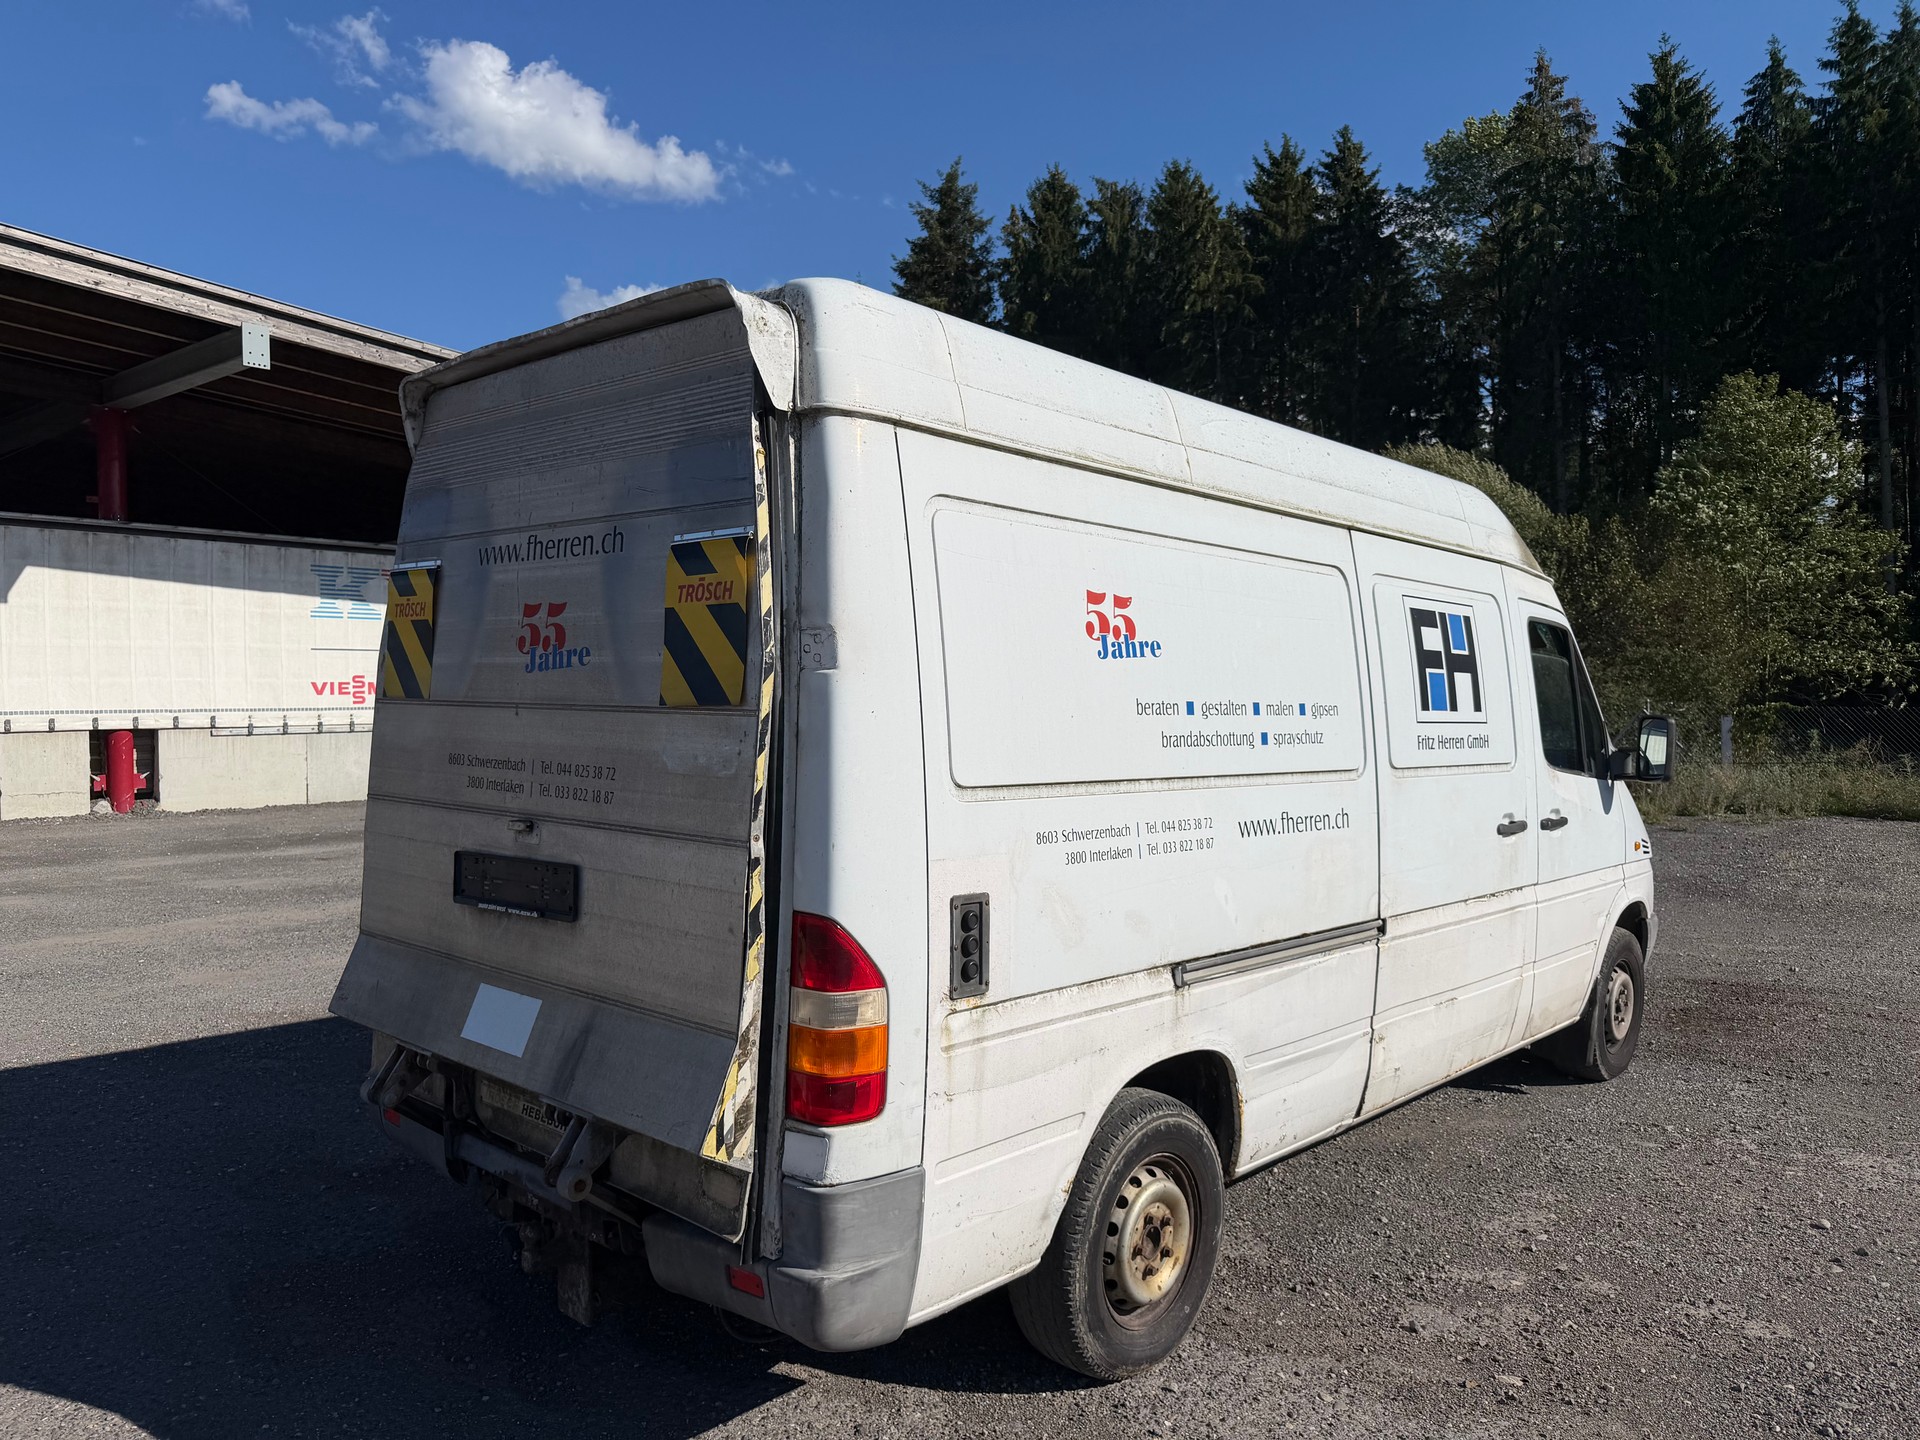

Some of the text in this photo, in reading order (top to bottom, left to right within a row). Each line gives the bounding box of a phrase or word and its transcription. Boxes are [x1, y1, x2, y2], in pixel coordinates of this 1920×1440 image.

[478, 525, 625, 567] www.fherren.ch
[517, 601, 568, 655] 55
[1085, 588, 1137, 642] 55
[525, 643, 592, 674] Jahre
[1097, 633, 1162, 660] Jahre
[1135, 698, 1339, 719] beraten gestalten malen gipsen
[1161, 729, 1324, 749] brandabschottung sprayschutz
[1417, 734, 1490, 751] Fritz Herren GmbH
[448, 752, 617, 781] 8603 Schwerzenbach Tel. 044 825 38 72
[466, 775, 615, 805] 3800 Interlaken Tel. 033 822 18 87
[1035, 816, 1214, 846] 8603 Schwerzenbach Tel. 044 825 38 72
[1237, 807, 1350, 839] www.fherren.ch
[1064, 837, 1215, 866] 3800 Interlaken Tel. 033 822 18 87
